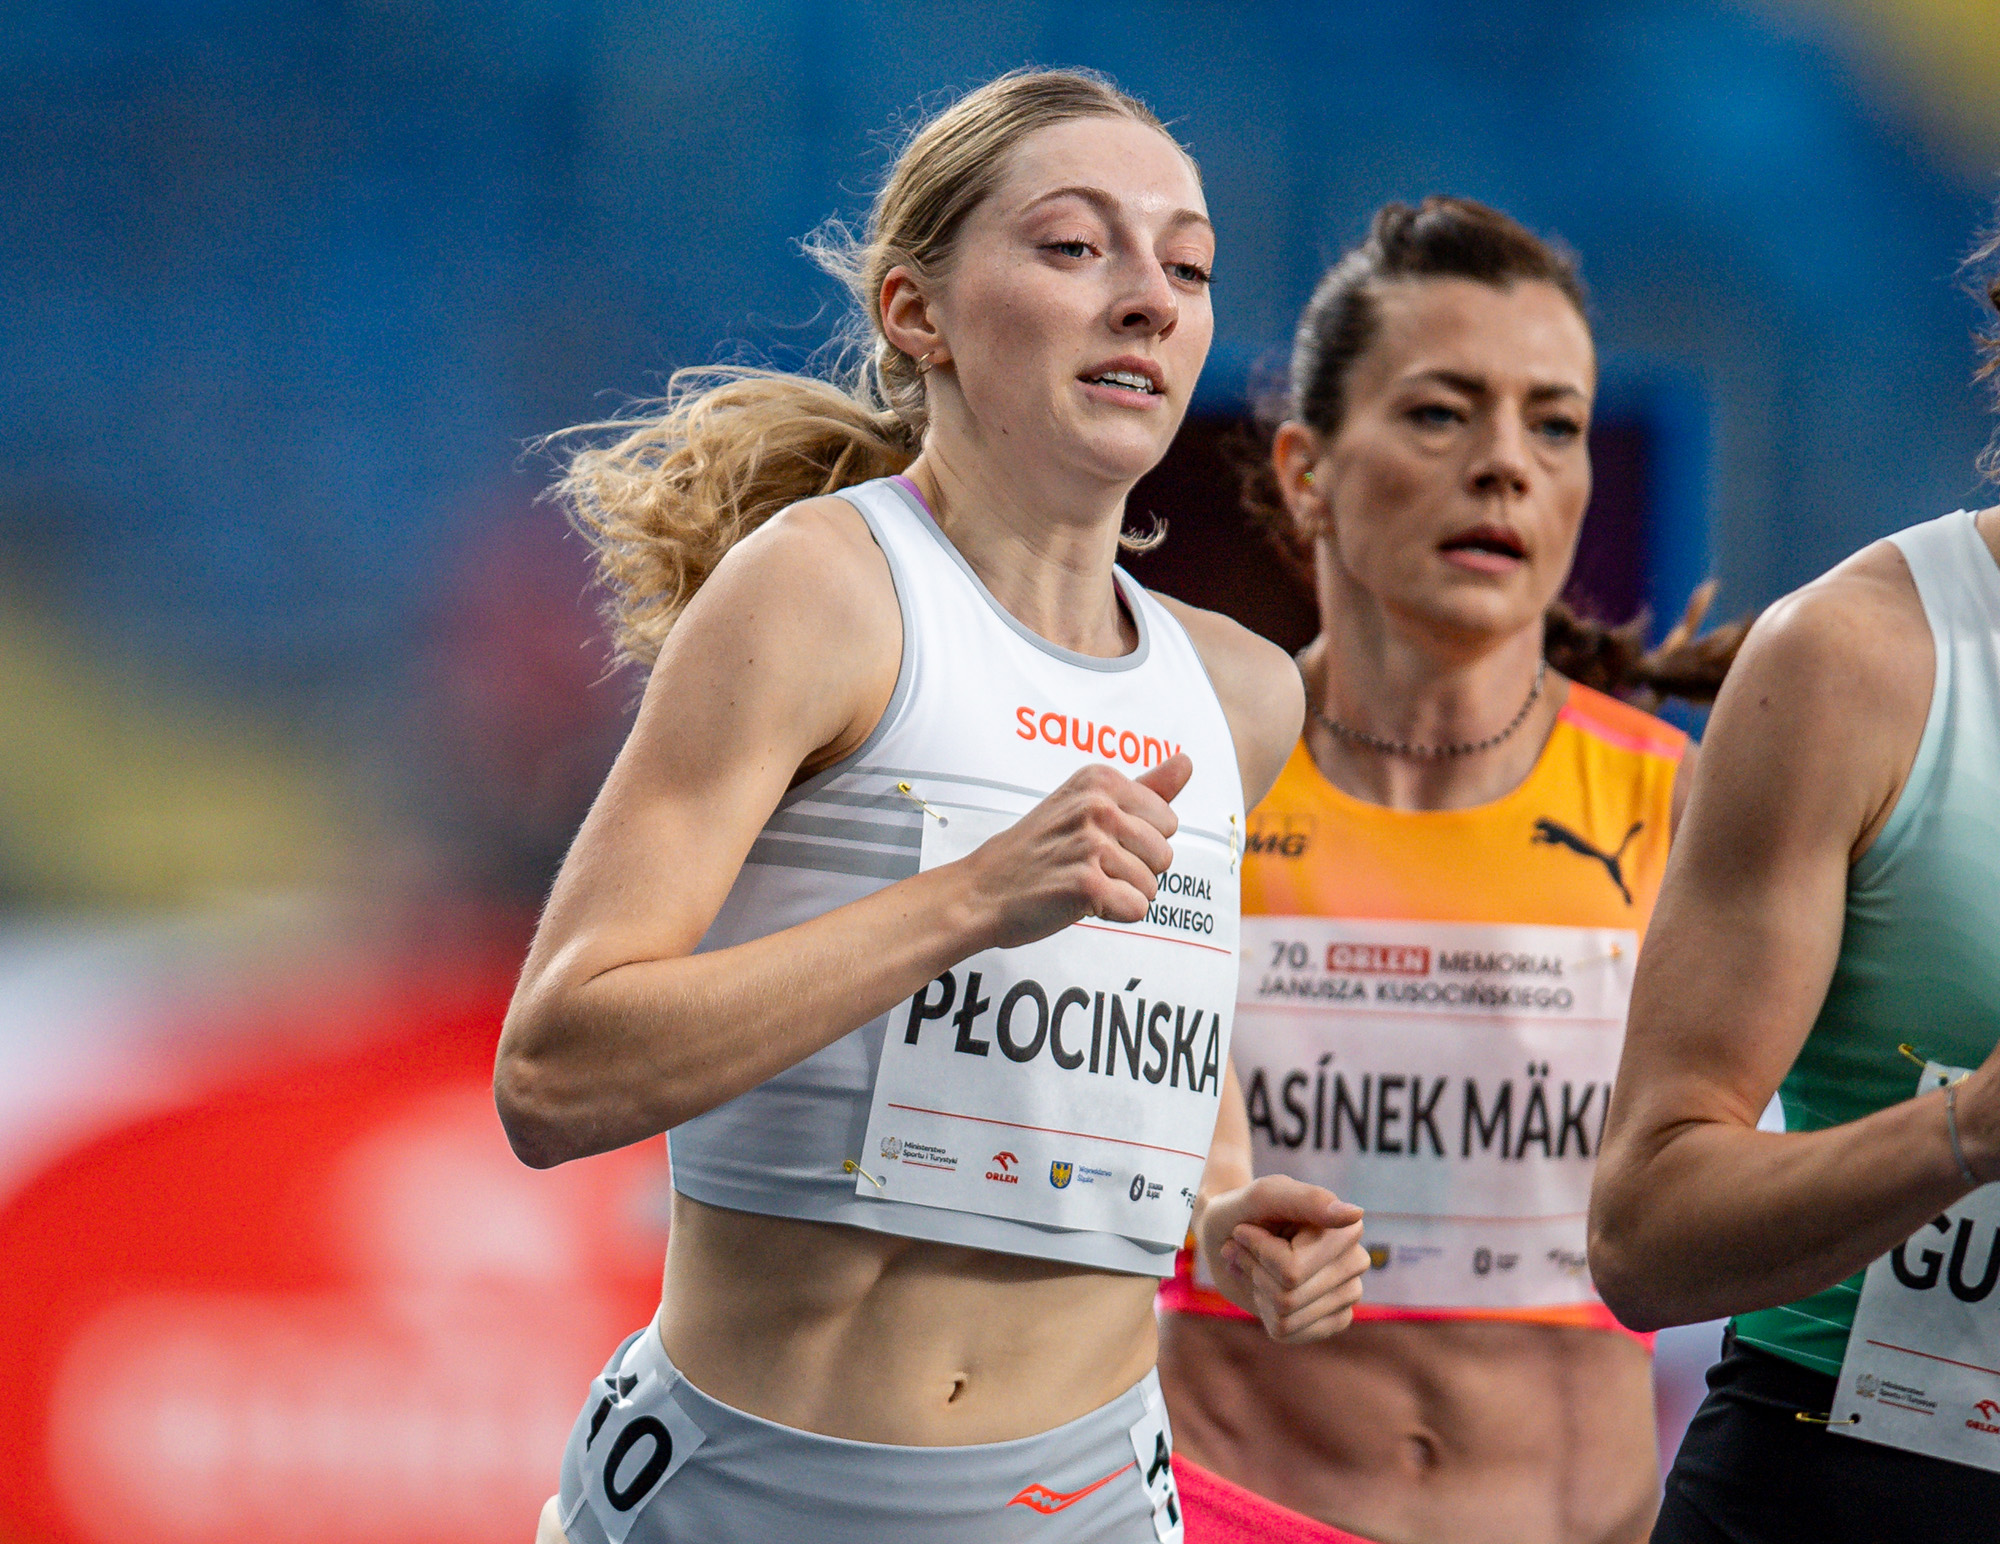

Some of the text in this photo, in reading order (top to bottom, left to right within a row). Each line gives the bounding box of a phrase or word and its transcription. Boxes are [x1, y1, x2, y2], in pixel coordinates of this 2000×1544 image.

[1155, 871, 1212, 901] MORIAŁ
[1145, 897, 1214, 935] ŃSKIEGO
[1334, 949, 1423, 973] ORLEN
[1257, 977, 1367, 999] JANUSZA
[904, 970, 1220, 1097] PŁOCIŃSKA
[1249, 1052, 1447, 1157] ASÍNEK
[902, 1149, 925, 1162] Sportu
[904, 1141, 947, 1155] Ministerstwo
[985, 1171, 1019, 1184] ORLEN
[1890, 1212, 2000, 1303] GU
